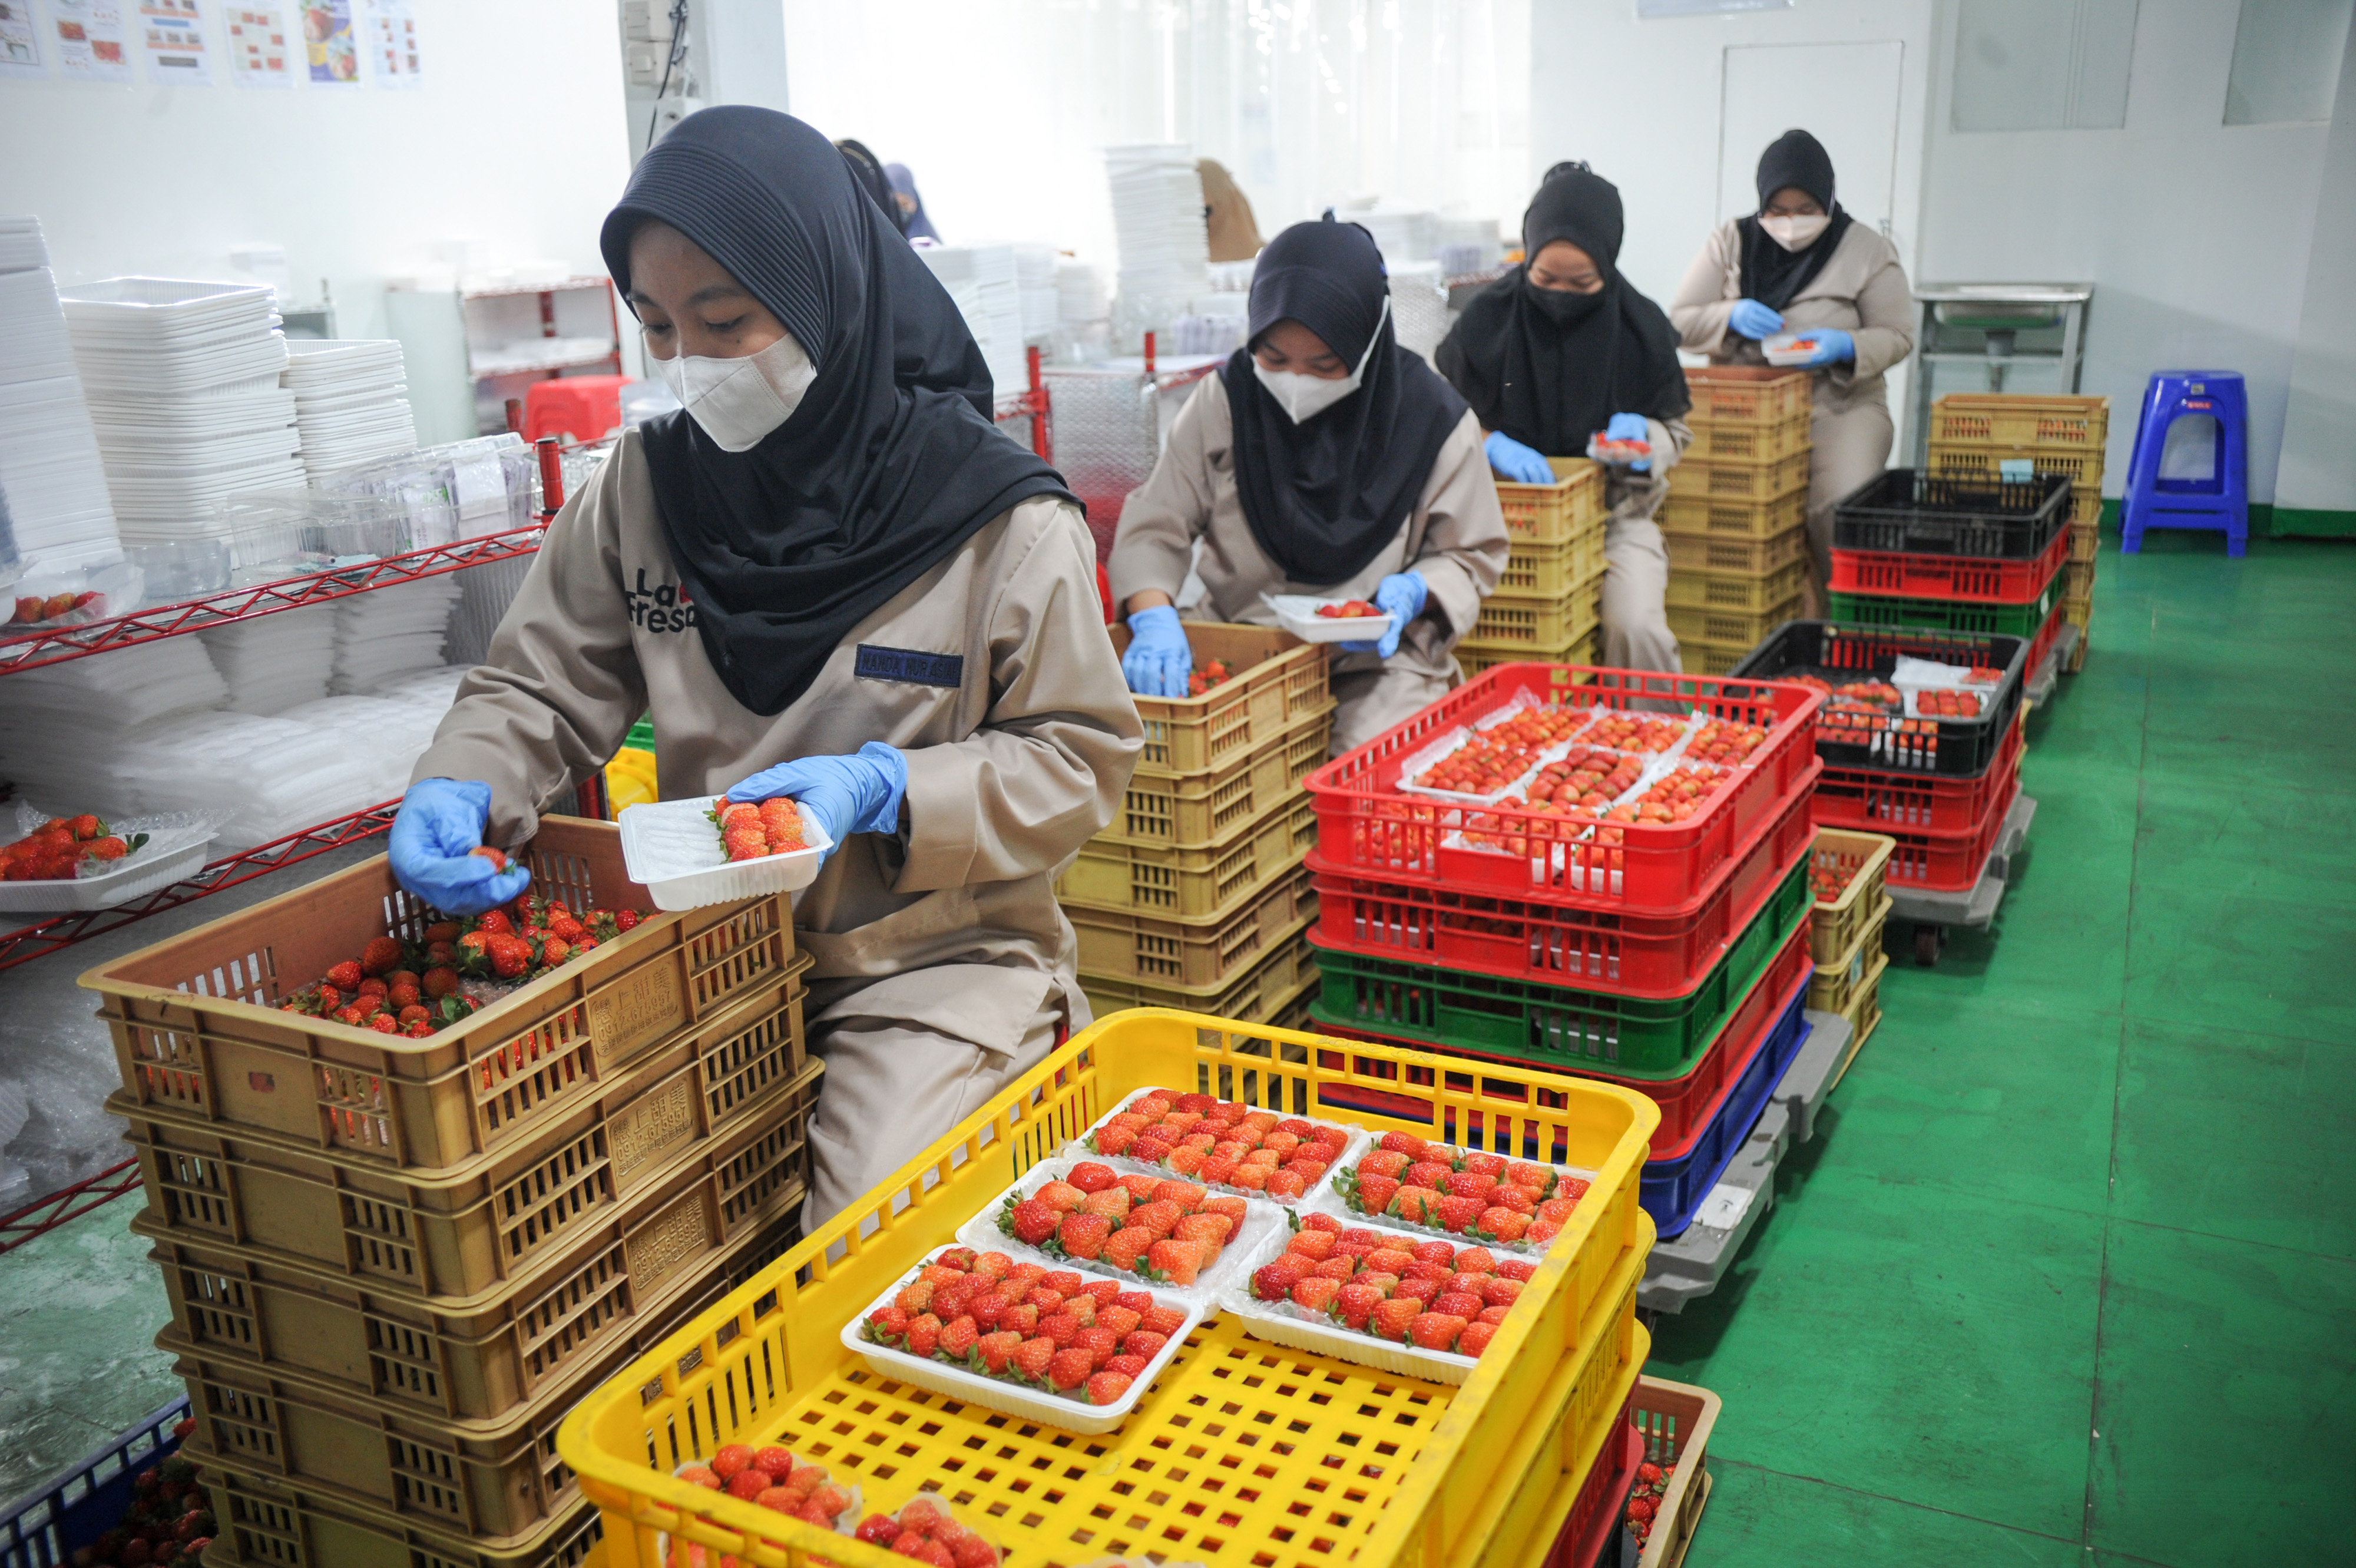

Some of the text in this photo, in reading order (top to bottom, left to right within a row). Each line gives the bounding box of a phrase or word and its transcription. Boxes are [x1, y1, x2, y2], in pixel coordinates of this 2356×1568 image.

[626, 591, 698, 633] Fresa
[637, 568, 676, 607] La
[598, 989, 671, 1041] 0912-675957
[616, 1105, 687, 1162] 0912-675957
[634, 1215, 703, 1276] 0912-675957
